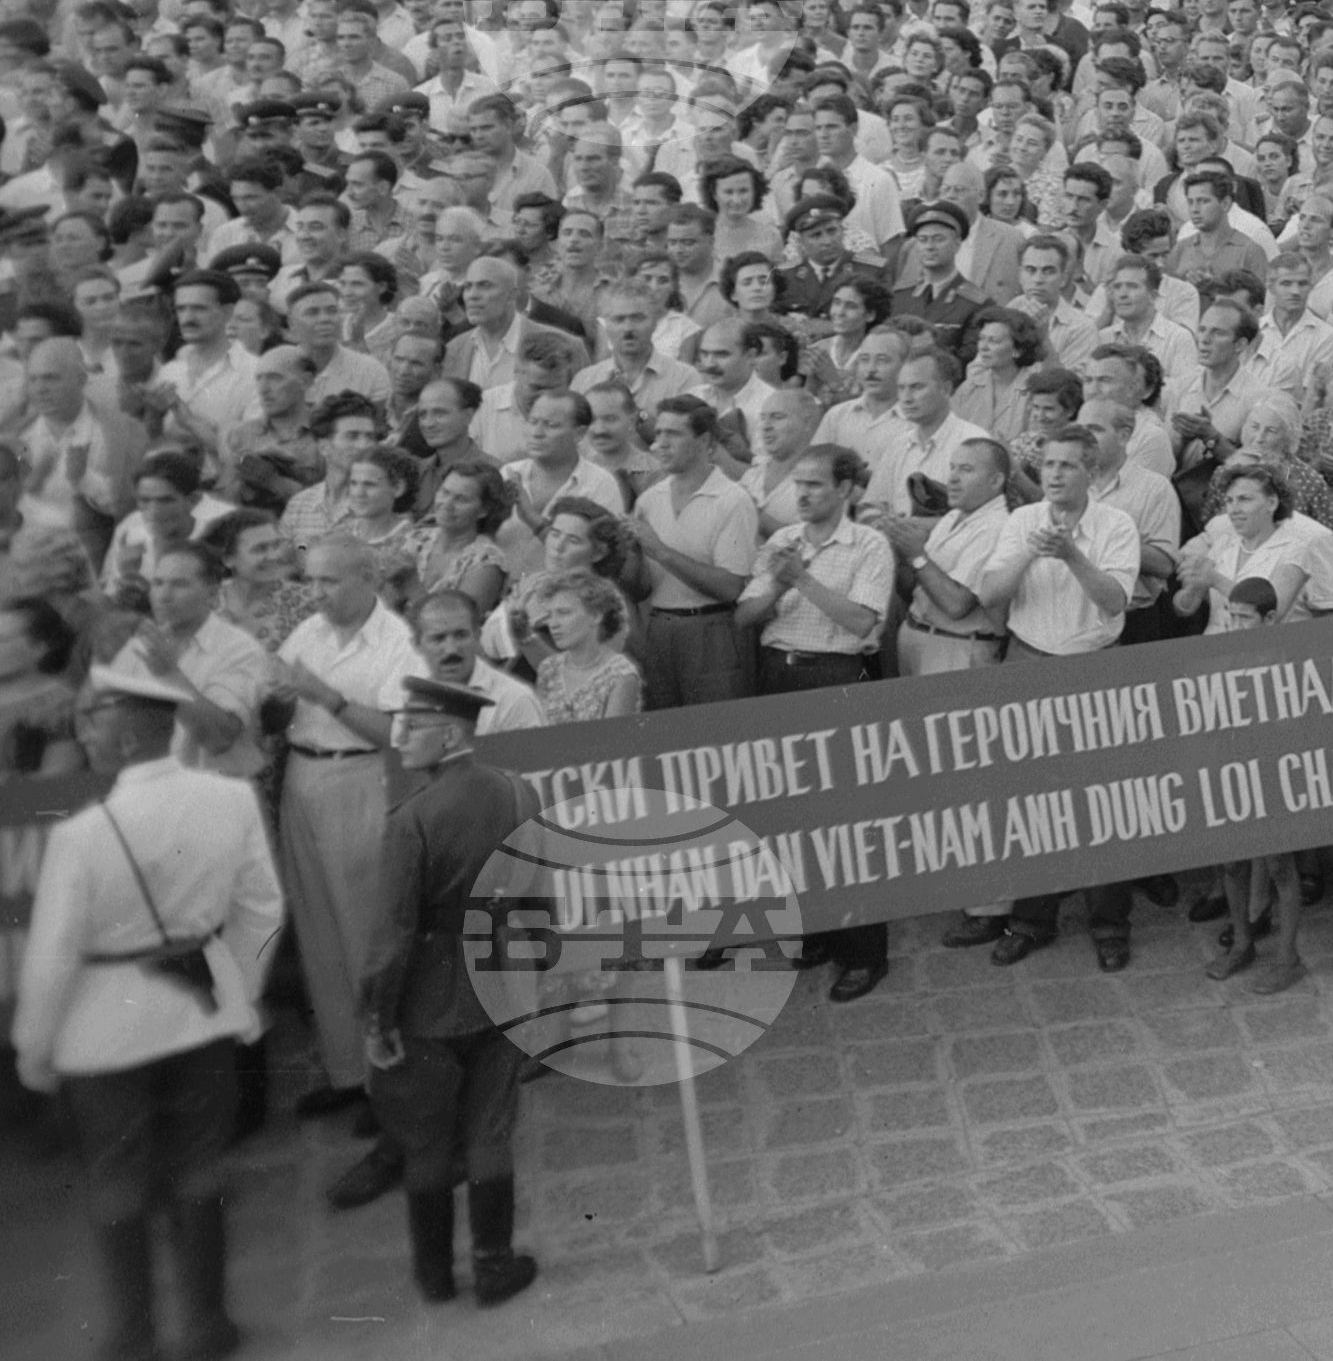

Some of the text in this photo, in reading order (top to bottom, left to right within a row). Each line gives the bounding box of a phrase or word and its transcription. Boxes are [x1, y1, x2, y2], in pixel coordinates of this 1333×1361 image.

[655, 728, 839, 815] ПРИВЕТ
[850, 718, 921, 787] НА
[923, 682, 1166, 776] ГЕРОИЧНИЯ
[603, 844, 723, 926] NHAN
[727, 829, 810, 905] DAN
[810, 800, 996, 891] VIET-NAM
[1001, 788, 1081, 861] ANH
[1084, 771, 1188, 847] DUNG
[1197, 758, 1268, 828] LOI
